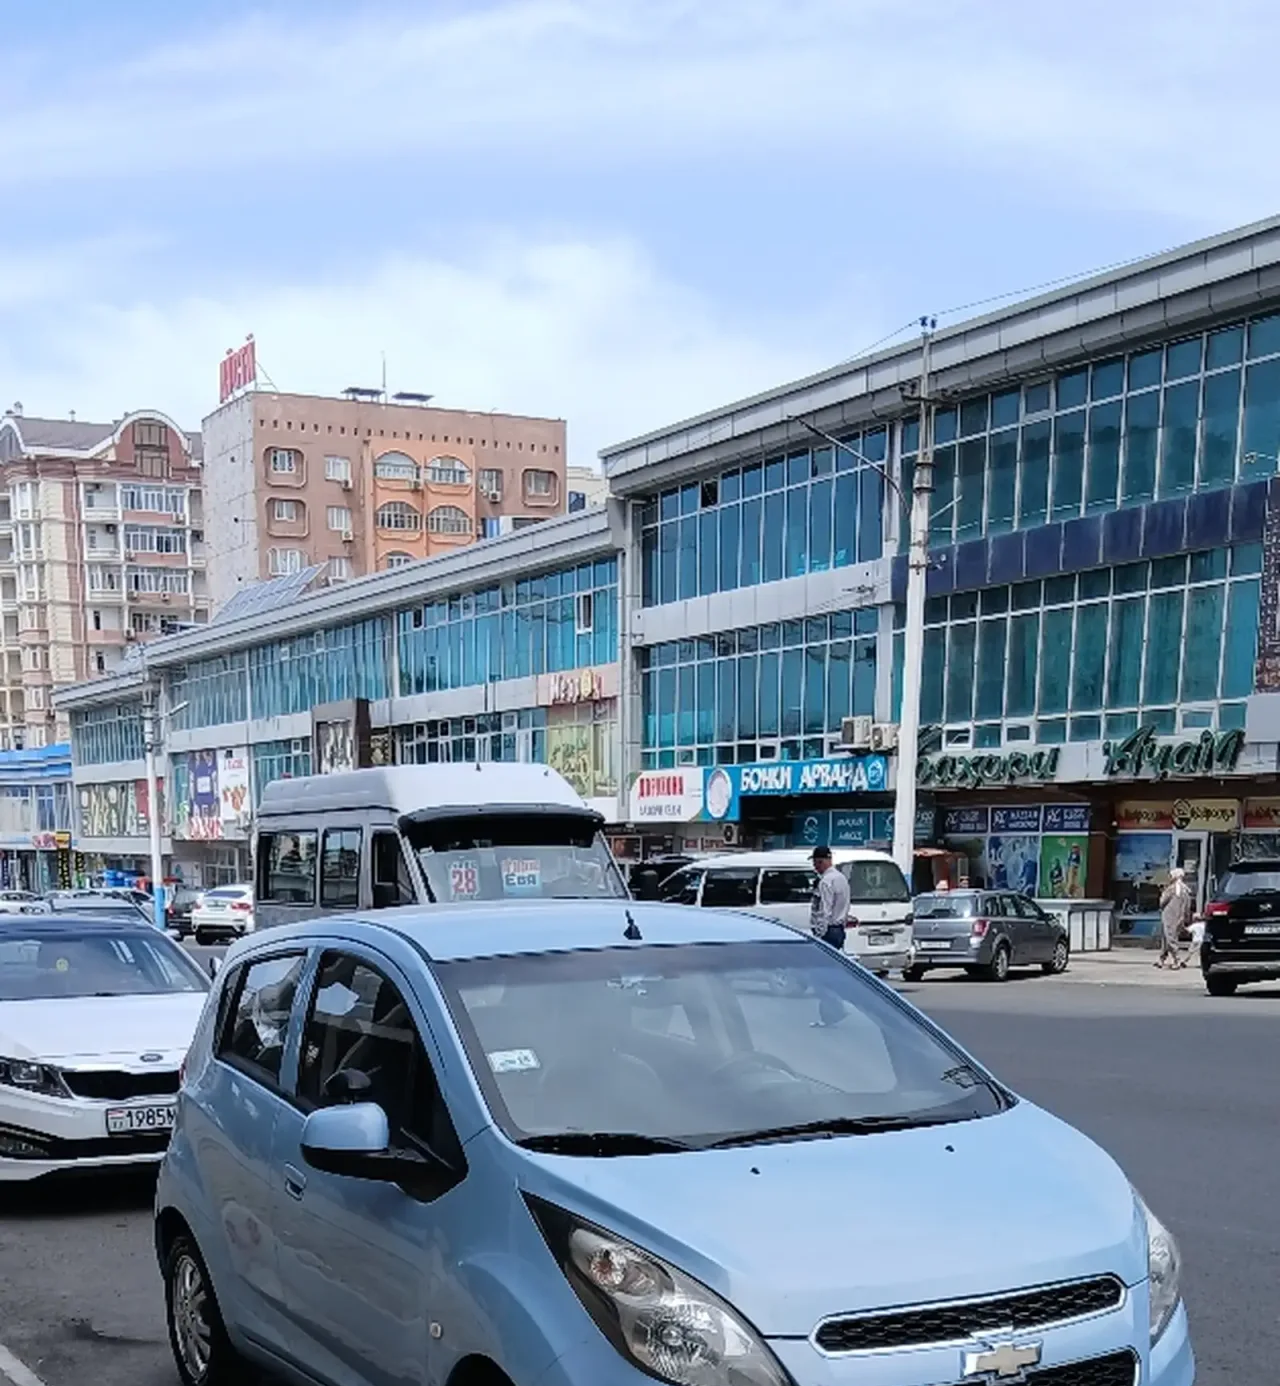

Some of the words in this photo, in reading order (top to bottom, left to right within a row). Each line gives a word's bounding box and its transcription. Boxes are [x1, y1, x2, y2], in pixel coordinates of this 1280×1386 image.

[740, 766, 793, 791] БОНКИ
[799, 761, 869, 791] АРВАНД
[452, 868, 477, 893] 28
